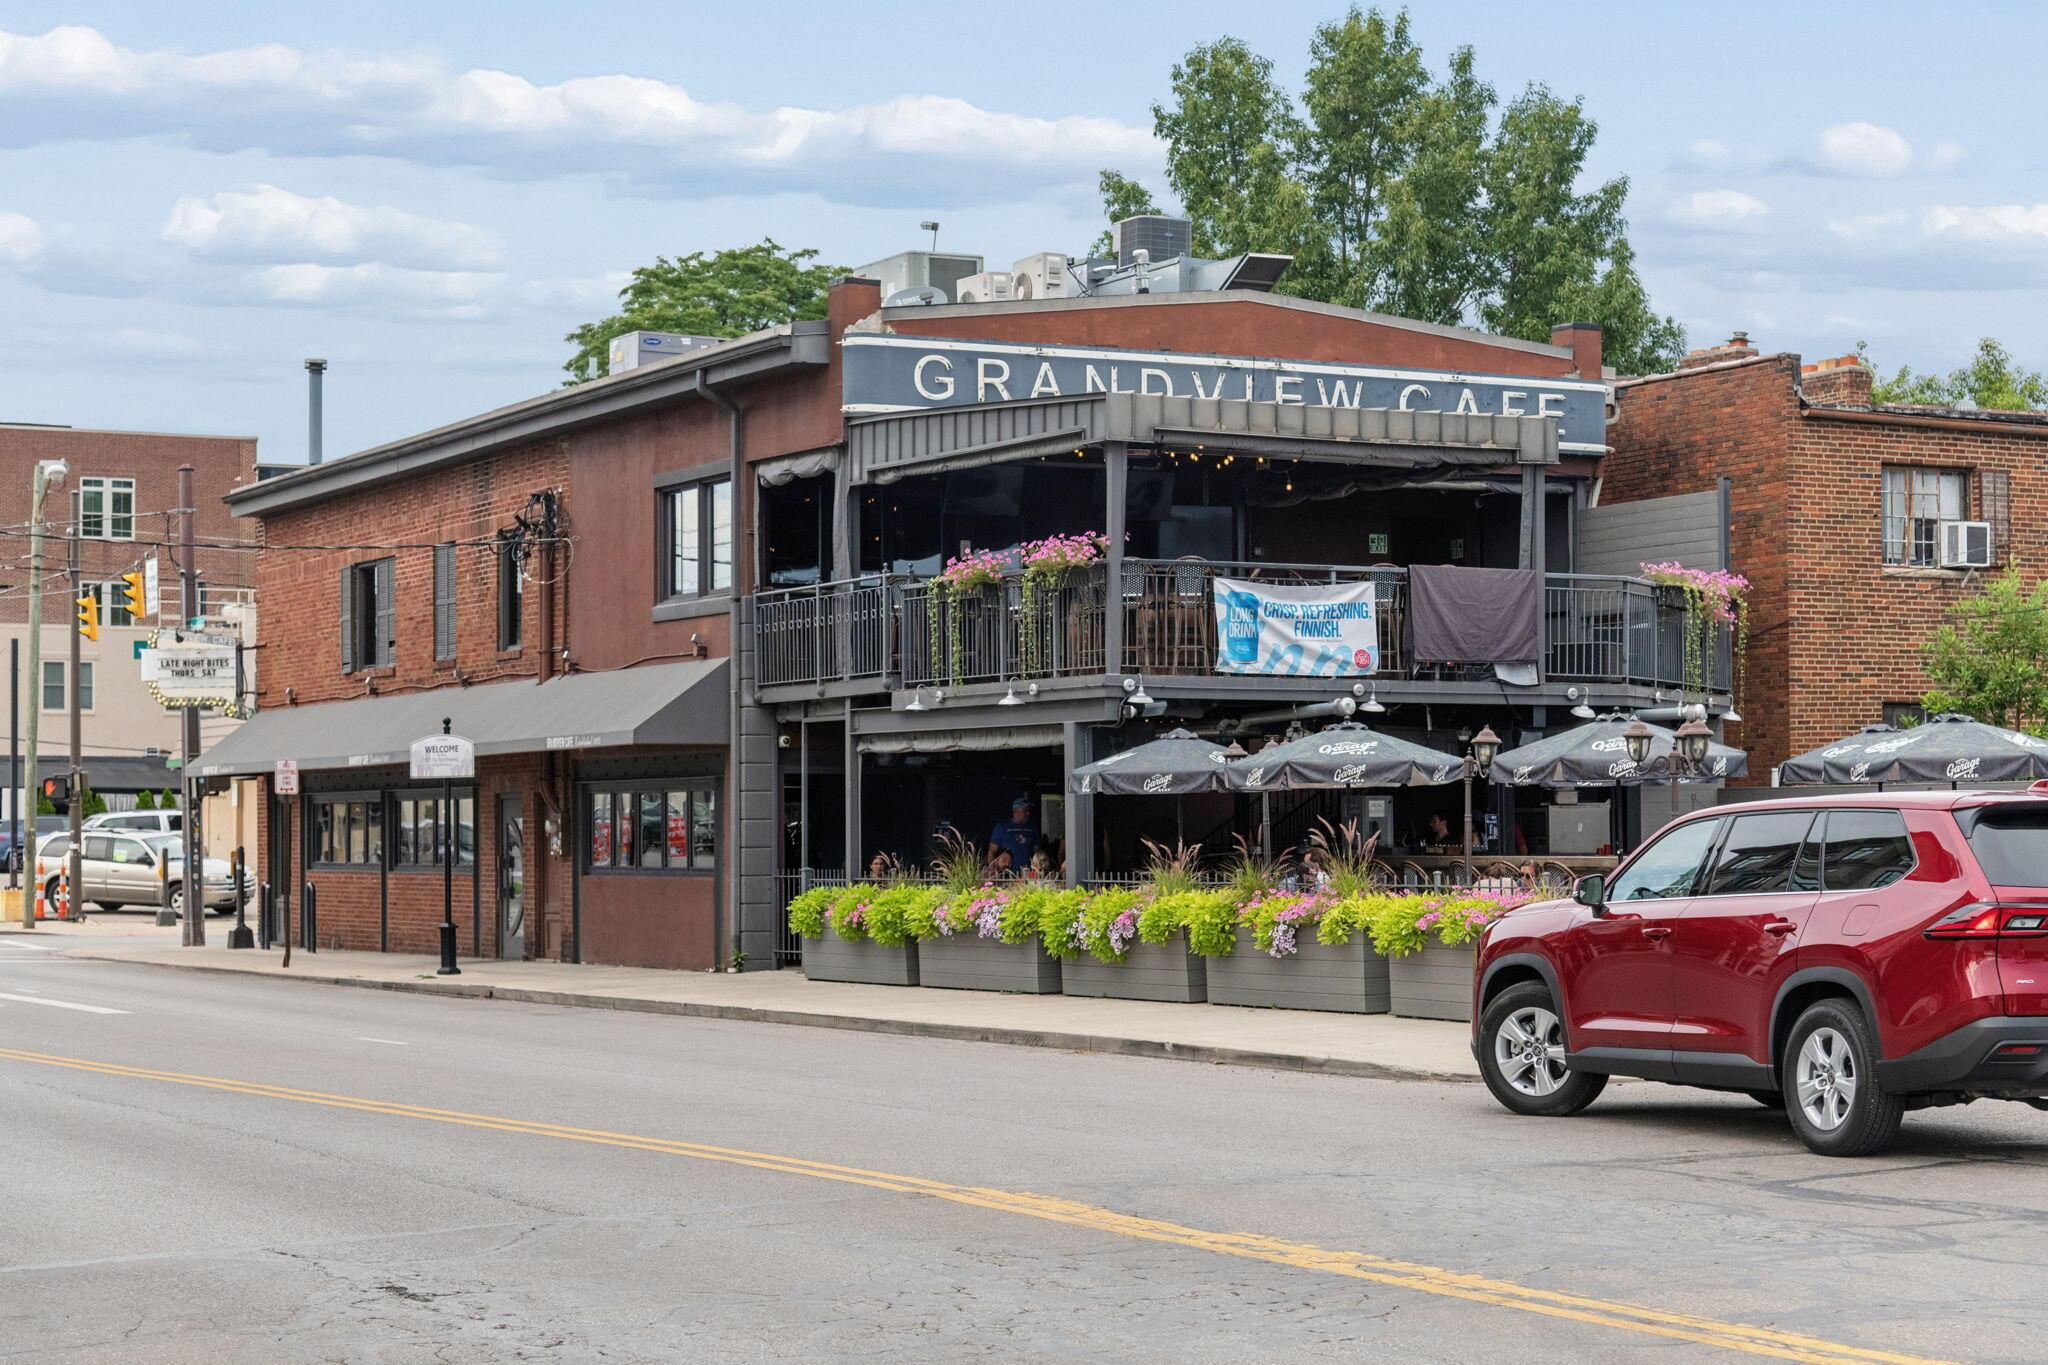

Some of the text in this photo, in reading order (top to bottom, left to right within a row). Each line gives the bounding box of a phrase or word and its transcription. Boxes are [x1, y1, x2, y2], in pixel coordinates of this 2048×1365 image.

[913, 354, 1566, 435] GRANDVIEW CAFE
[1230, 607, 1254, 623] LONG
[1263, 601, 1372, 620] CRISP. REFRESHING.
[1293, 621, 1342, 638] FINNISH.
[160, 659, 229, 668] LATE NIGHT BITES
[171, 669, 217, 677] THURS SAT
[425, 745, 459, 753] WELCOME
[1333, 764, 1366, 782] Garage
[1609, 760, 1638, 778] Garag
[1947, 757, 1981, 779] Garage
[1144, 773, 1173, 792] Garage
